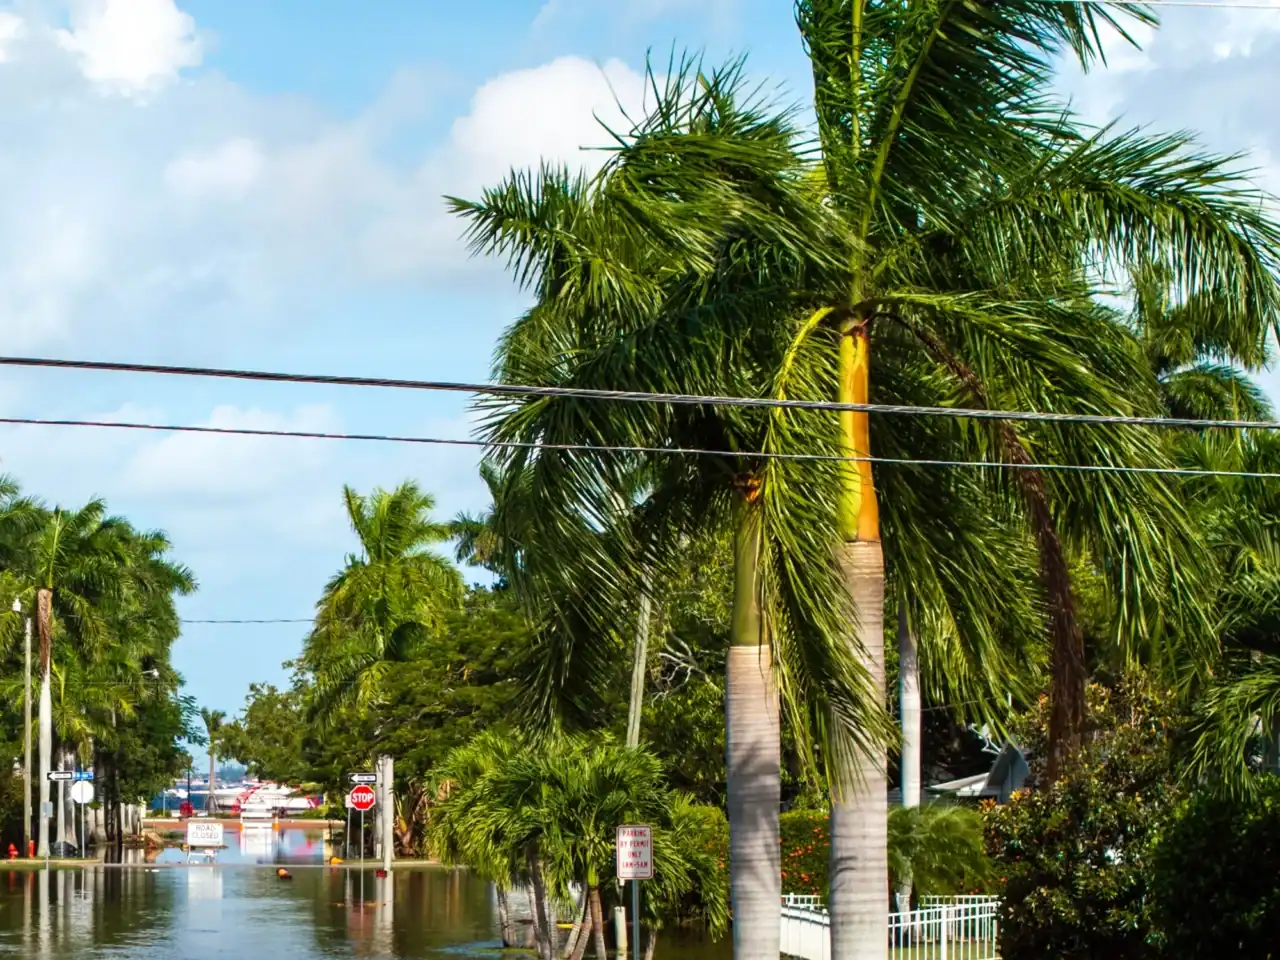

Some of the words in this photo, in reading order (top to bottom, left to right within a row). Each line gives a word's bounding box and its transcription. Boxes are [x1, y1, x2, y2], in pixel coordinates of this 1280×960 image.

[352, 793, 373, 803] STOP
[196, 824, 216, 832] ROAD
[192, 831, 218, 839] CLOSED
[623, 829, 646, 837] PARKING
[620, 840, 628, 849] BY
[630, 840, 648, 848] PERMIT
